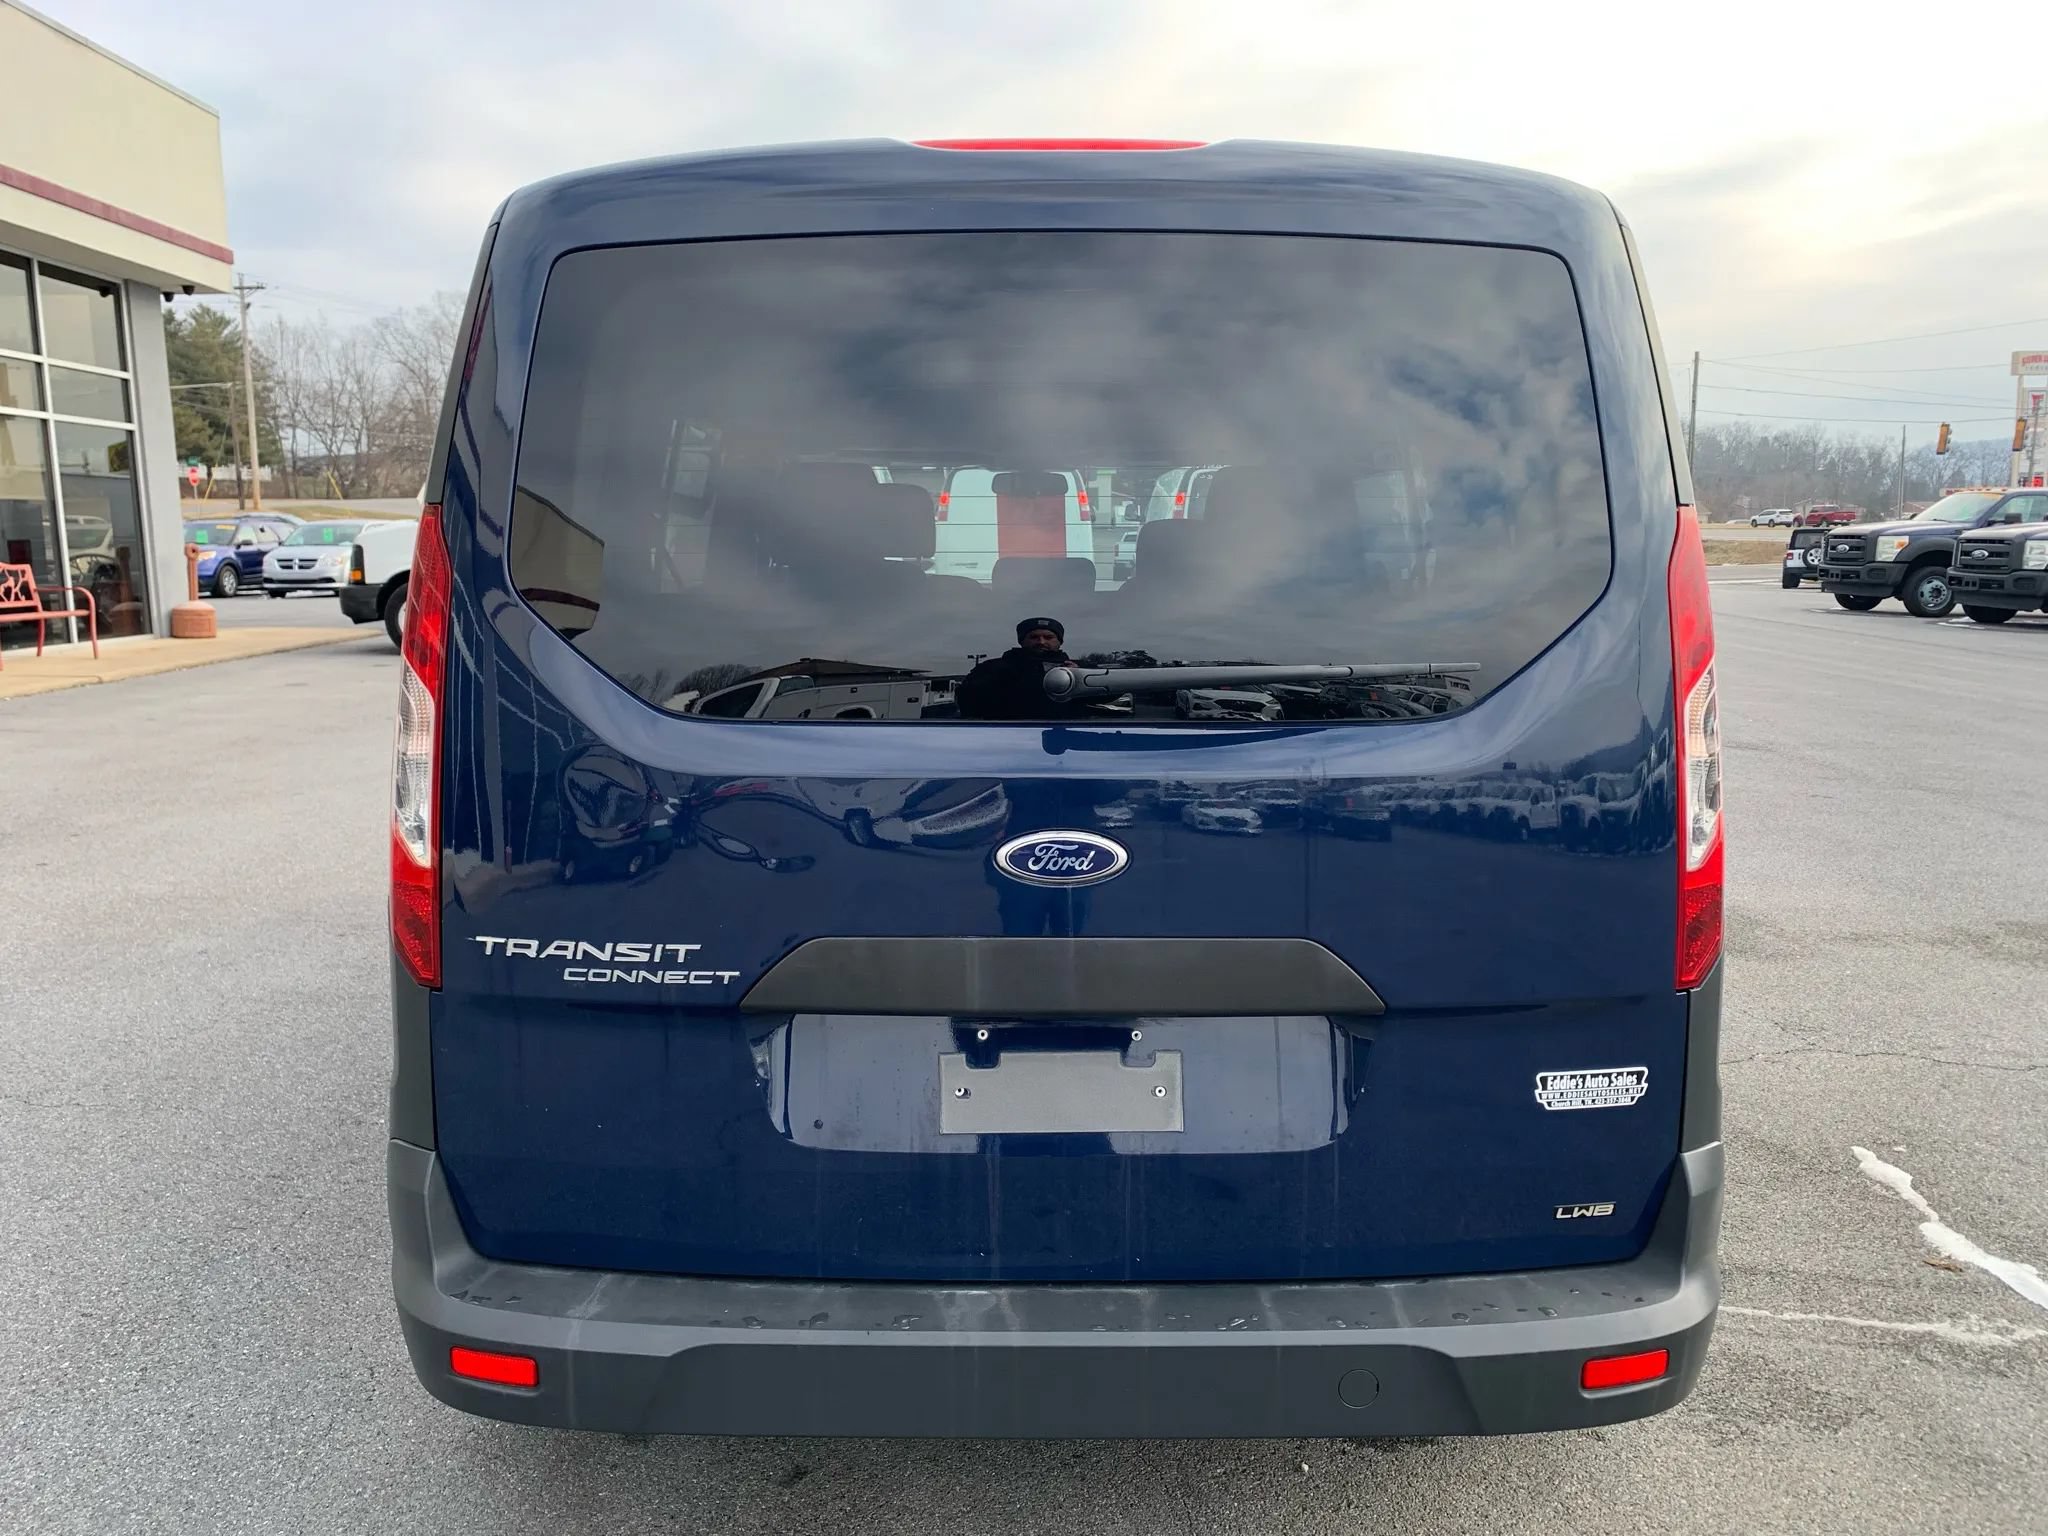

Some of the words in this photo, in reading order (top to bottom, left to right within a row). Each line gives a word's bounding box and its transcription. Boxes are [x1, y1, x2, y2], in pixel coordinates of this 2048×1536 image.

[1028, 843, 1096, 871] Ford
[473, 936, 702, 963] TRANSIT
[563, 967, 741, 985] CONNECT
[1547, 1075, 1584, 1091] Eddie's
[1584, 1074, 1610, 1089] Auto
[1610, 1072, 1638, 1087] Sales
[1541, 1087, 1642, 1100] WWW.EDDIESAUTOSALES.NET
[1556, 1204, 1615, 1219] LWB
